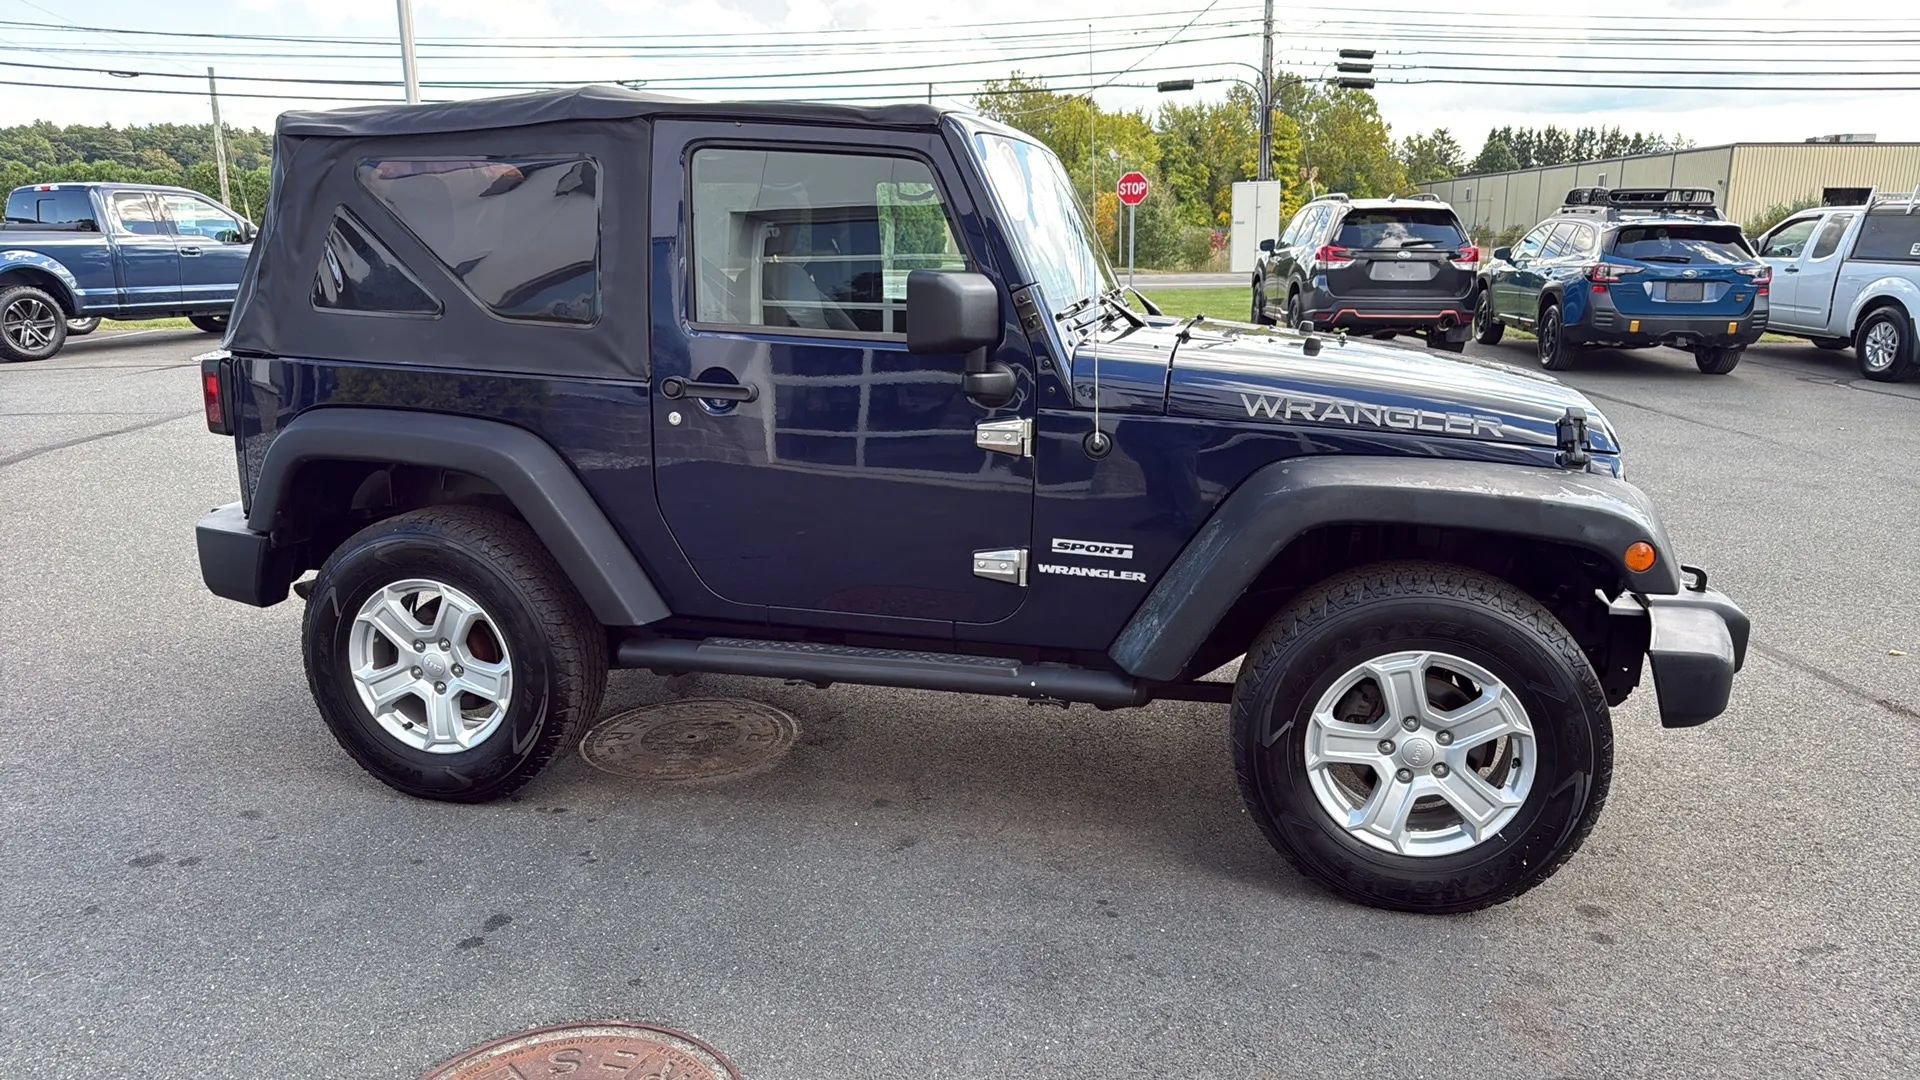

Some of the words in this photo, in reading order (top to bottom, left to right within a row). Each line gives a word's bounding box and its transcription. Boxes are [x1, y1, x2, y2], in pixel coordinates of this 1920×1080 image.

[1119, 181, 1146, 196] STOP
[1240, 393, 1504, 438] WRANGLER
[1057, 541, 1127, 556] SPORT
[1038, 563, 1147, 583] WRANGLER
